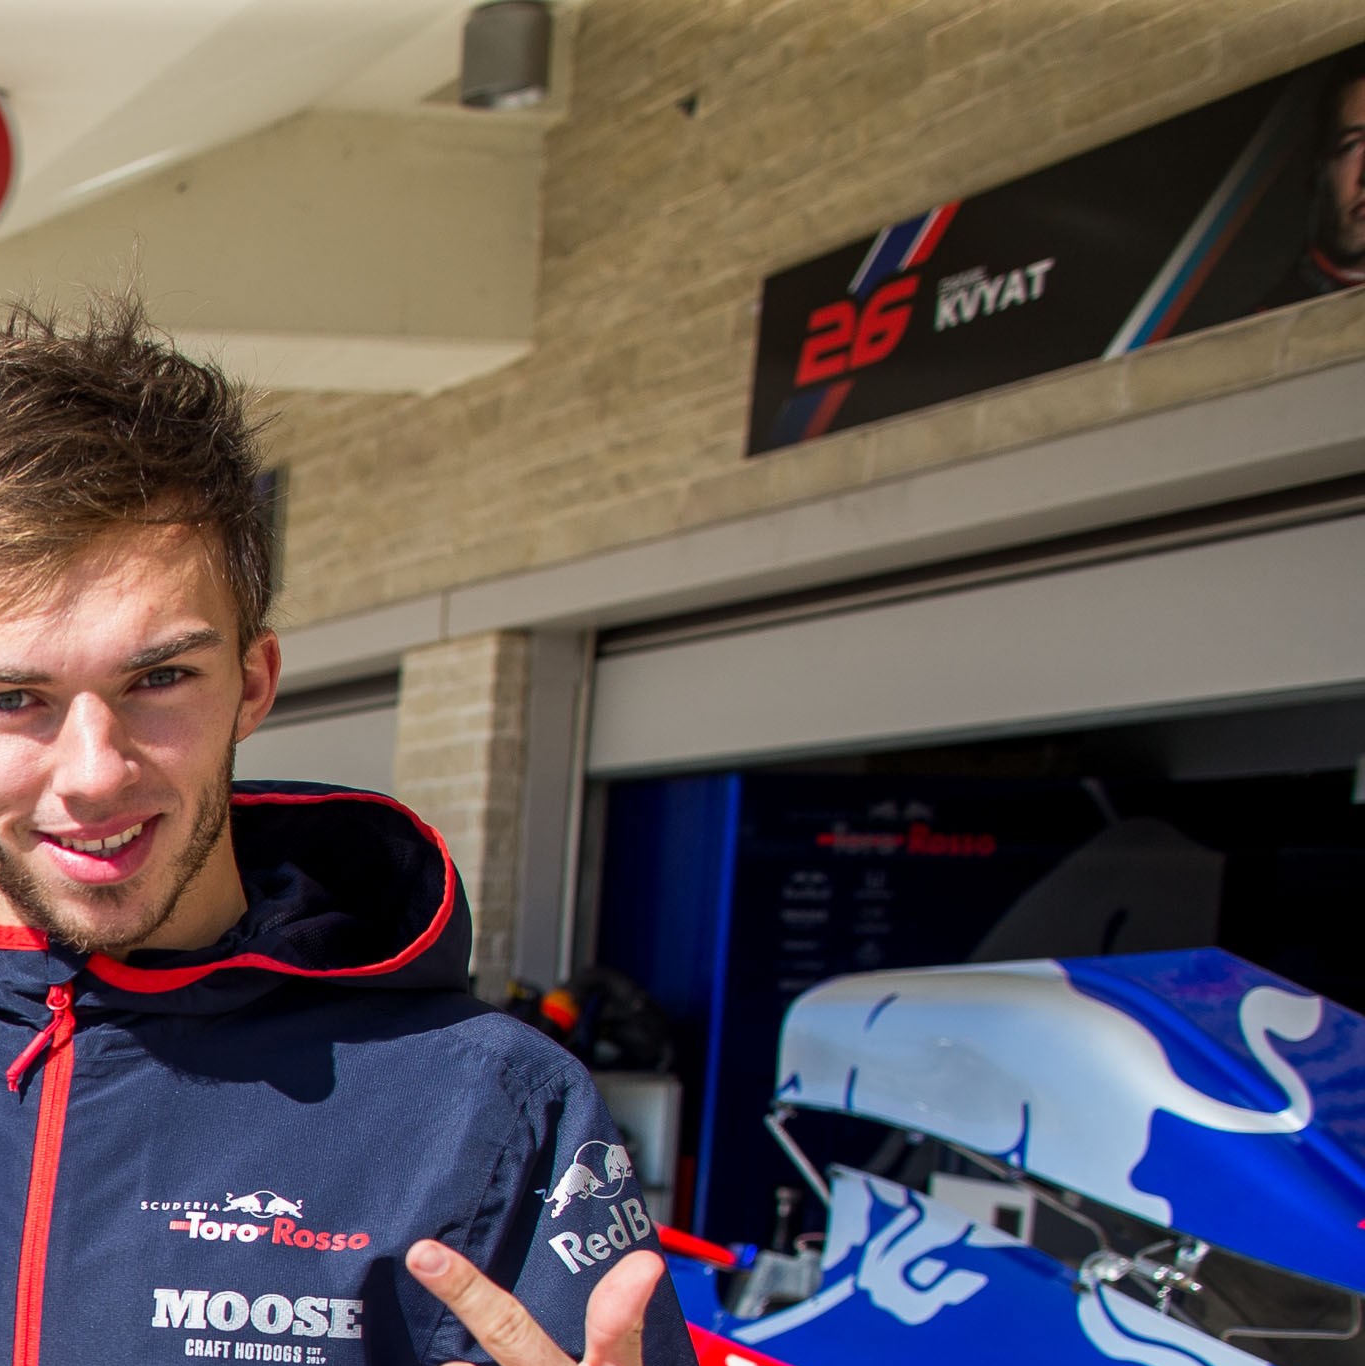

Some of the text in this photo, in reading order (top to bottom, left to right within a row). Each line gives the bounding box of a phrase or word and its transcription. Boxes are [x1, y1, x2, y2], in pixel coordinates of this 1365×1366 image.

[933, 257, 1055, 332] KVYAT
[794, 273, 920, 389] 26
[140, 1201, 219, 1211] SCUDERIA
[185, 1211, 371, 1251] Toro Rosso
[548, 1204, 631, 1275] Red
[151, 1288, 364, 1339] MOOSE
[184, 1338, 302, 1364] CRAFT HOTDOGS
[306, 1346, 322, 1355] EST
[306, 1355, 327, 1365] 2019
